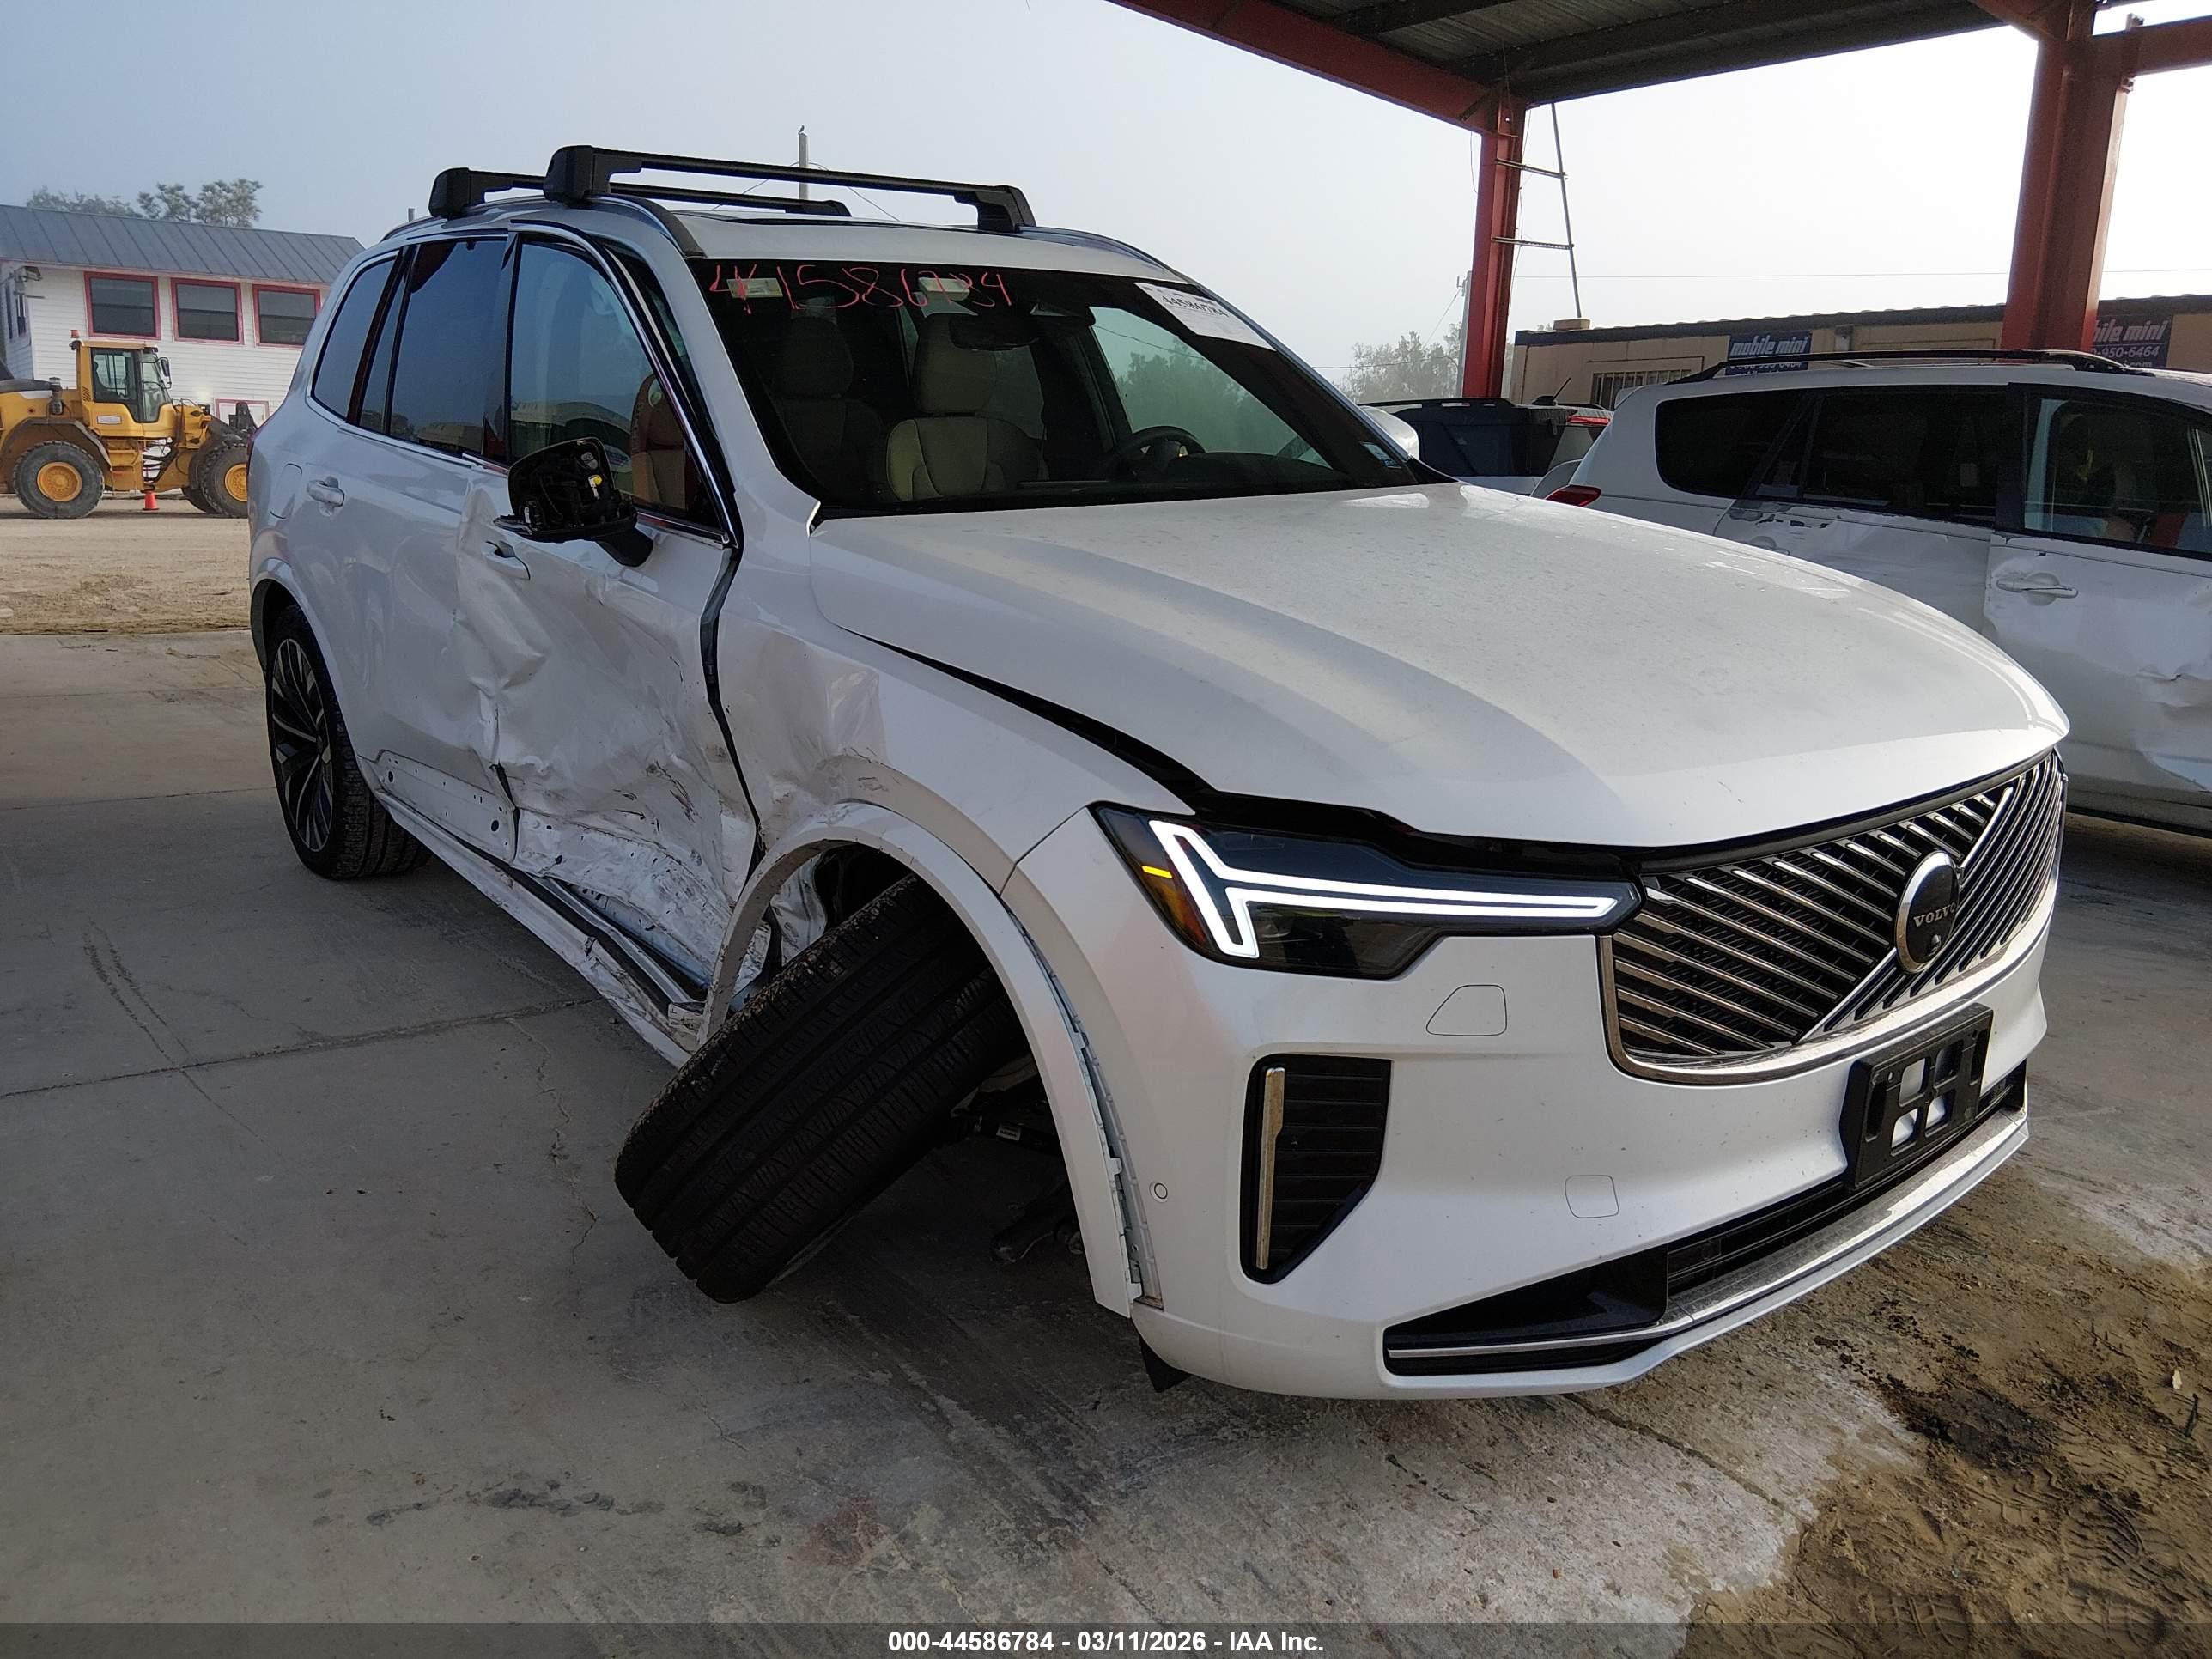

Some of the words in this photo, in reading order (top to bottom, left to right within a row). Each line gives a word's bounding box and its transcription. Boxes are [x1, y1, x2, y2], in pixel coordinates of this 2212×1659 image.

[2123, 320, 2168, 341] mini
[1730, 335, 1776, 356] mobile
[1775, 336, 1809, 354] mini
[1913, 902, 1957, 928] VOLVO
